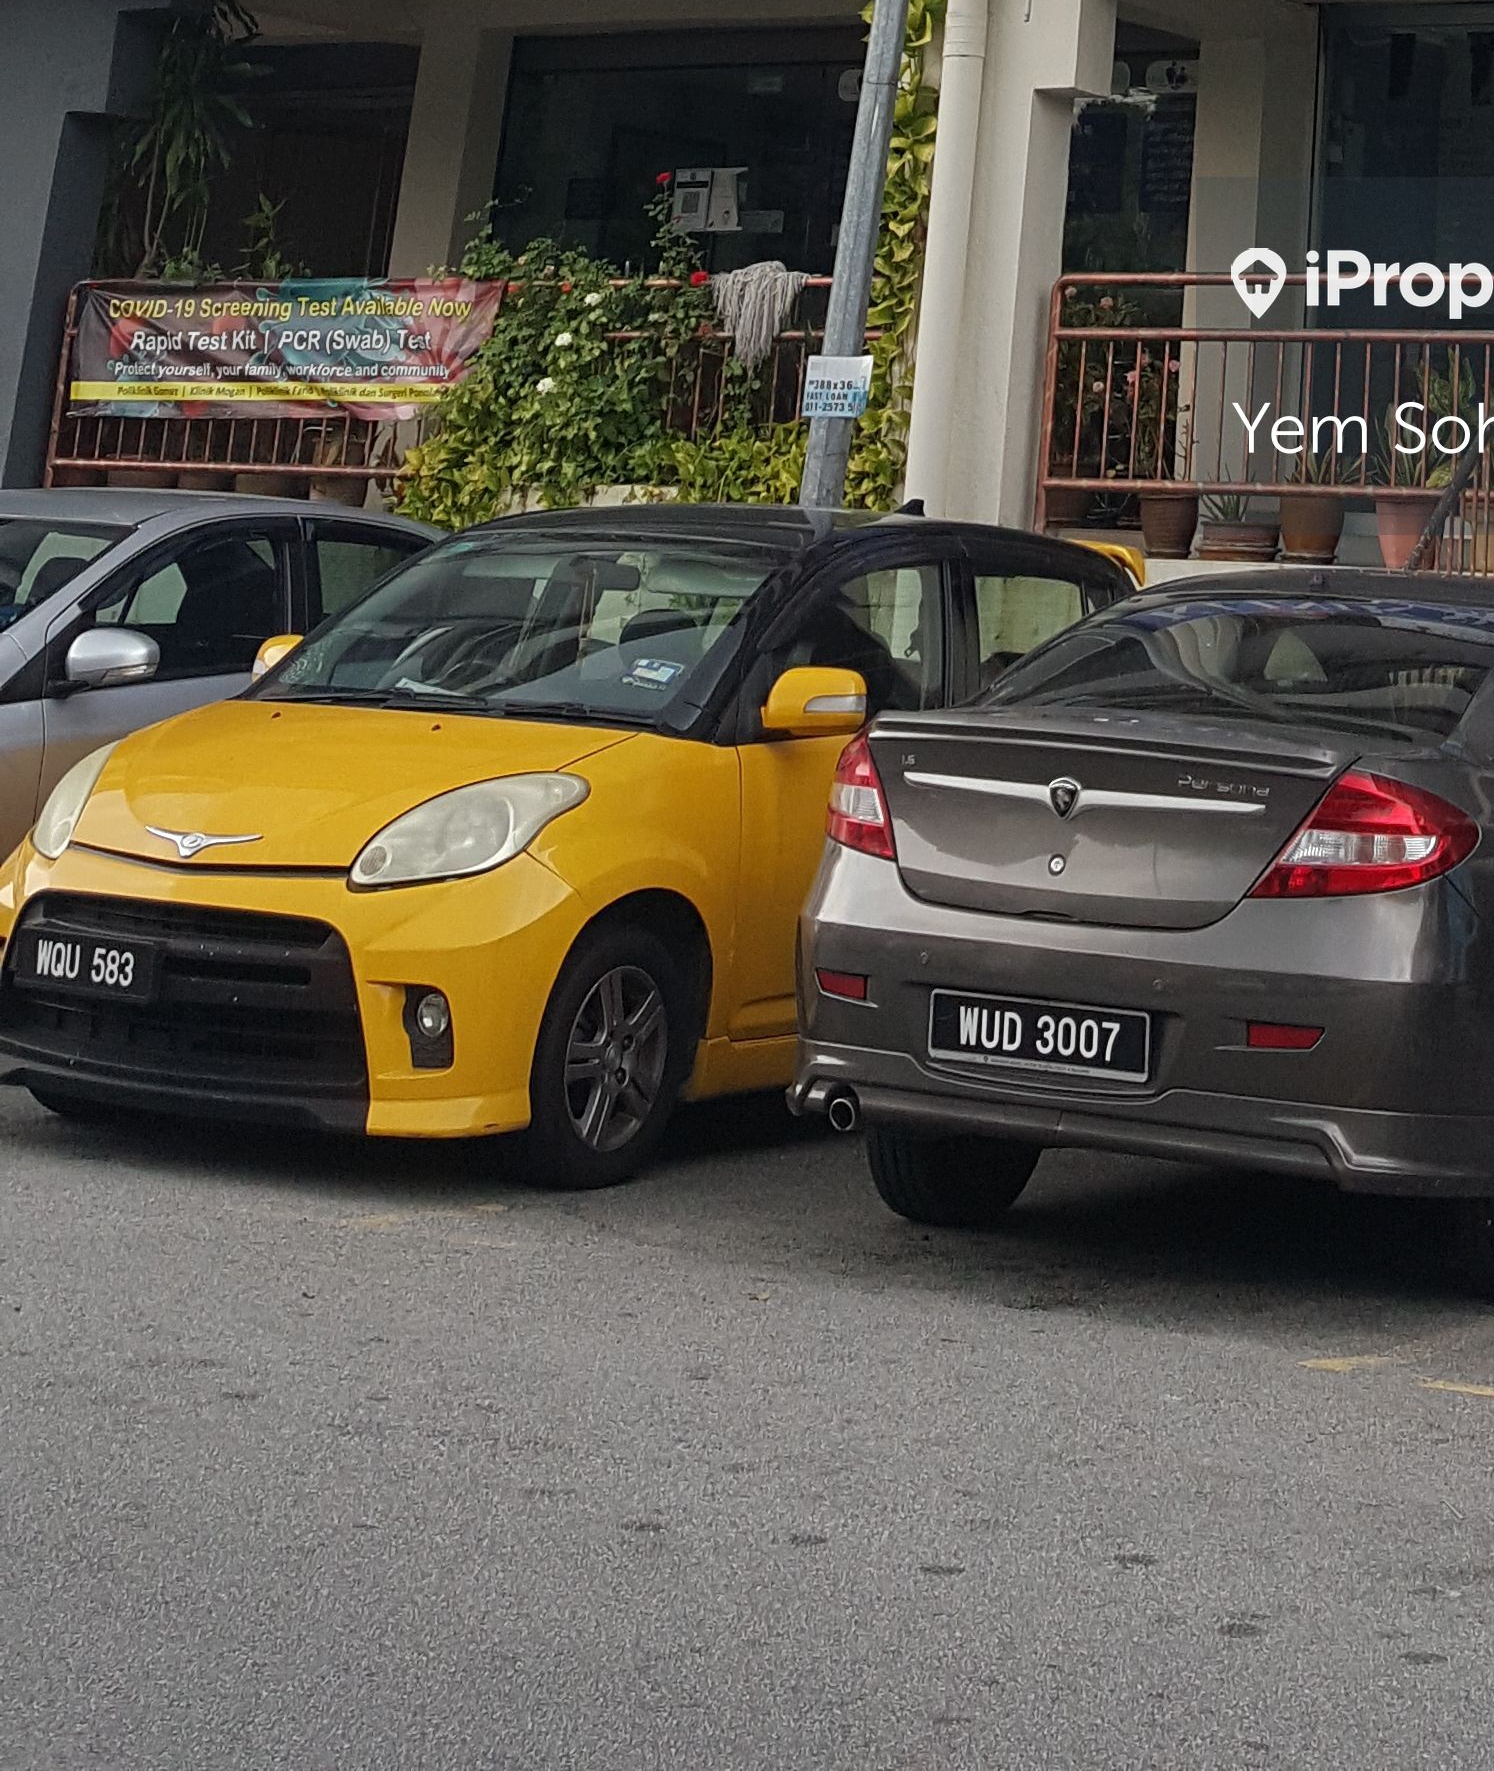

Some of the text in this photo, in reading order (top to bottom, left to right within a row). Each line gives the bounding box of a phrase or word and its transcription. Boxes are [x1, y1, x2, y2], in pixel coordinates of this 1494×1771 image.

[109, 295, 472, 321] COVID-19 Screening Test Available Now
[130, 329, 432, 355] Rapid Test Kit PCR (Swab) Test
[114, 361, 156, 375] Protect
[216, 364, 241, 379] your
[287, 363, 352, 377] workforce
[355, 363, 378, 376] and
[381, 364, 450, 379] community
[1178, 775, 1270, 797] Persona
[36, 939, 134, 987] WQU 583
[959, 1006, 1121, 1062] WUD 3007
